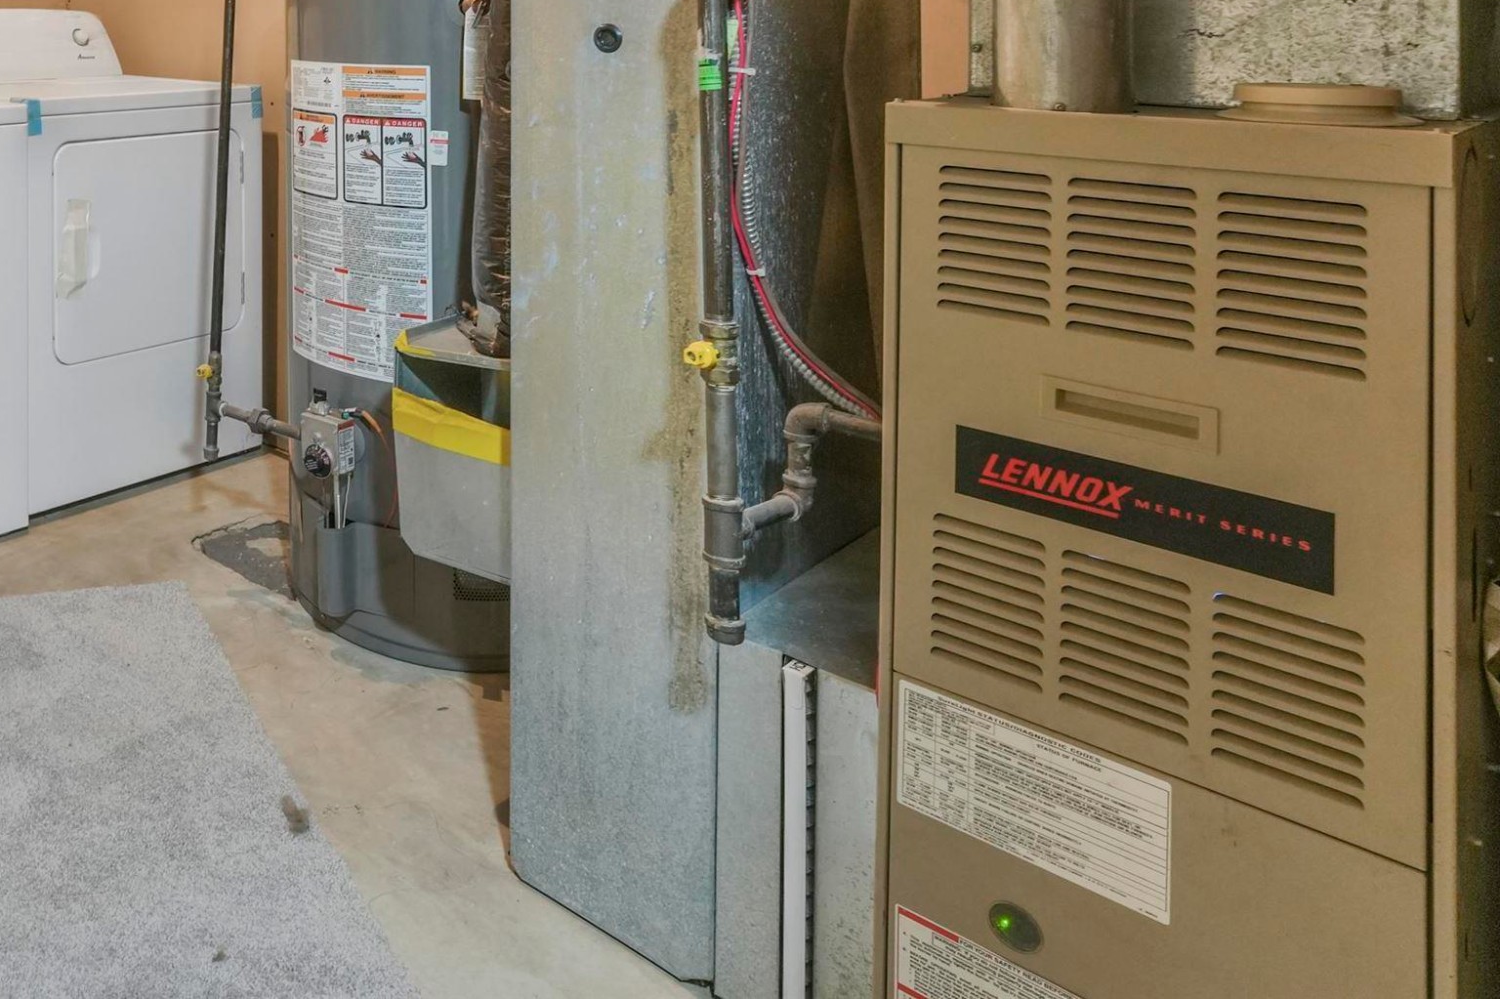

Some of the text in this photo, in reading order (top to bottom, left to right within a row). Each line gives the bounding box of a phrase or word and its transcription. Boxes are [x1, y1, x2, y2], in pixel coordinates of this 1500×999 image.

[981, 453, 1312, 552] LENNOX MERIT SERIES
[1071, 746, 1102, 762] CODES
[975, 945, 994, 959] YOUR
[994, 956, 1021, 974] SAFETY
